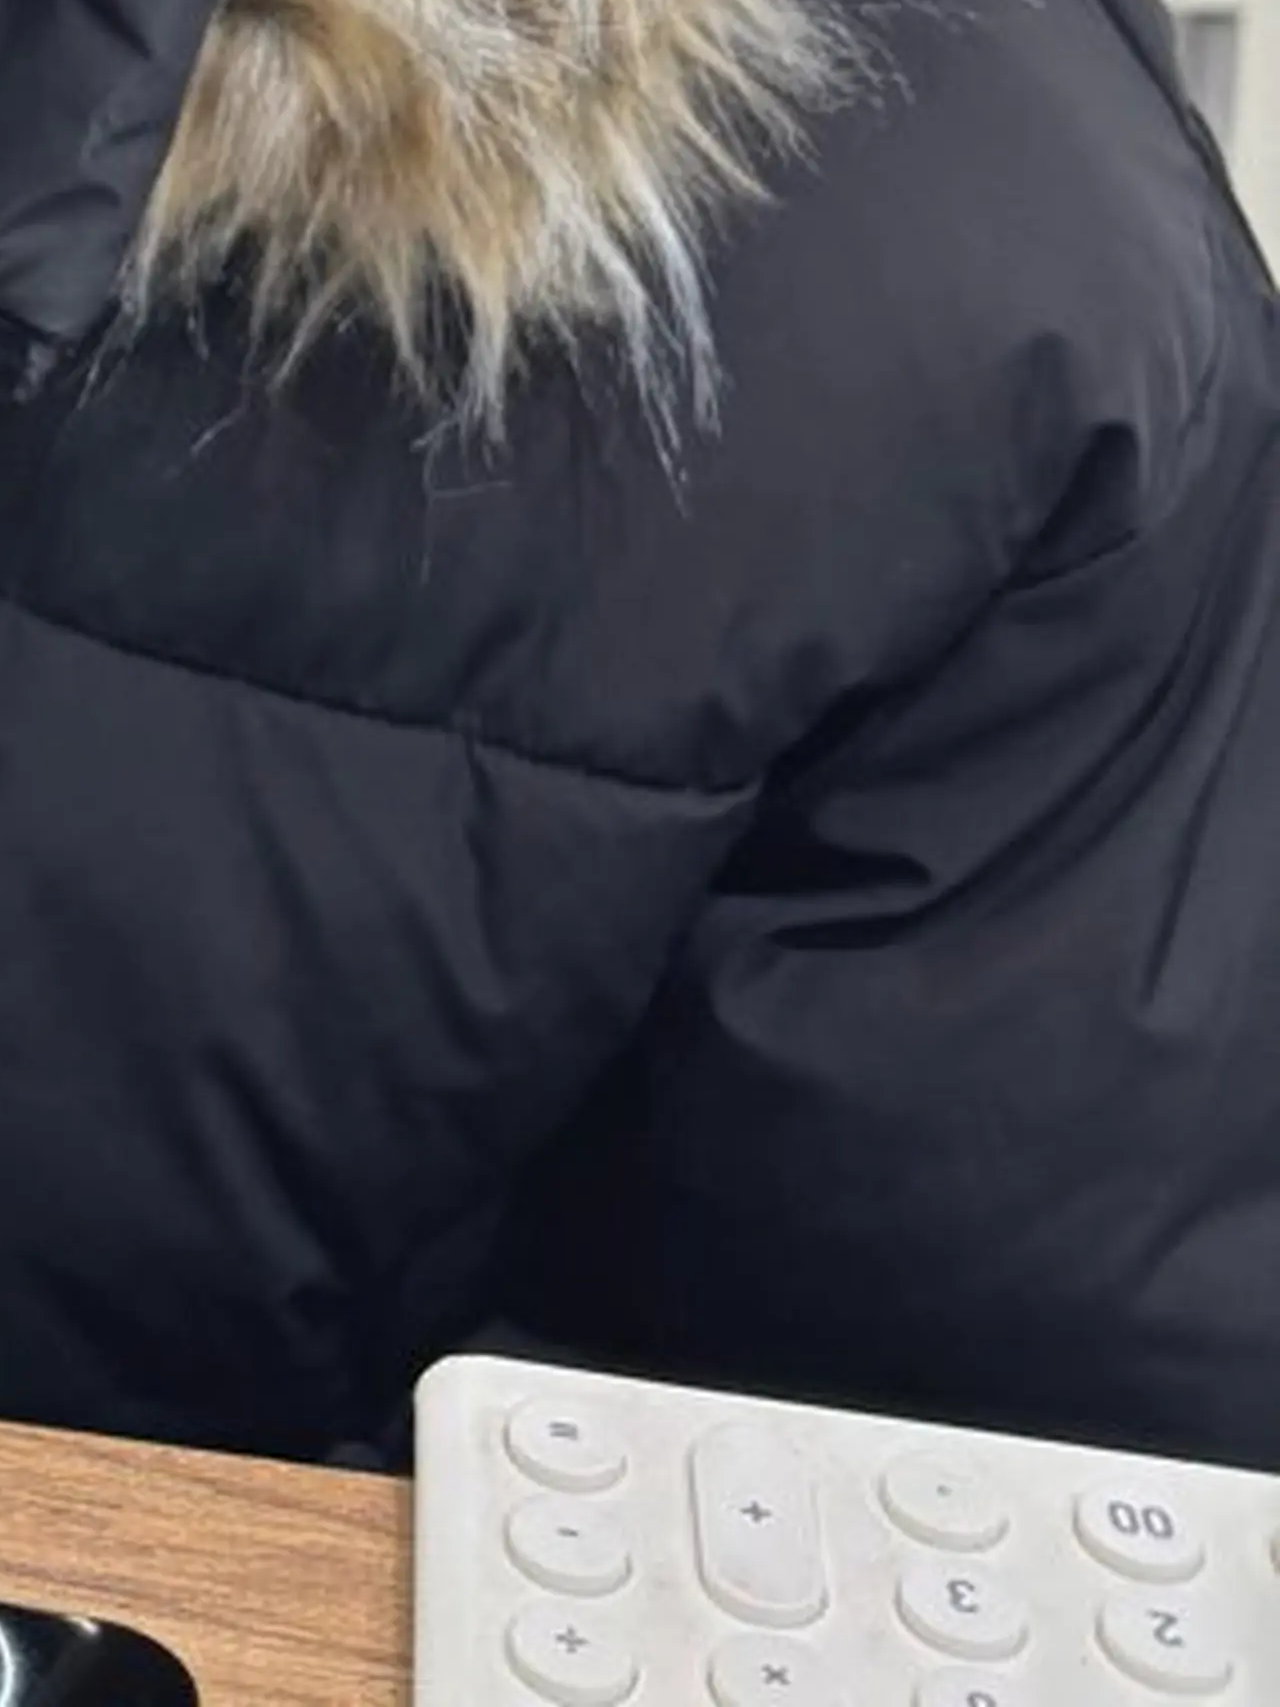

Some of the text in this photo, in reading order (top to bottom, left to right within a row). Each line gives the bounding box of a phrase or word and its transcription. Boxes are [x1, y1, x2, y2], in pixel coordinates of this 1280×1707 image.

[1107, 1499, 1176, 1541] 00
[945, 1578, 980, 1614] 3
[1144, 1608, 1188, 1648] 2
